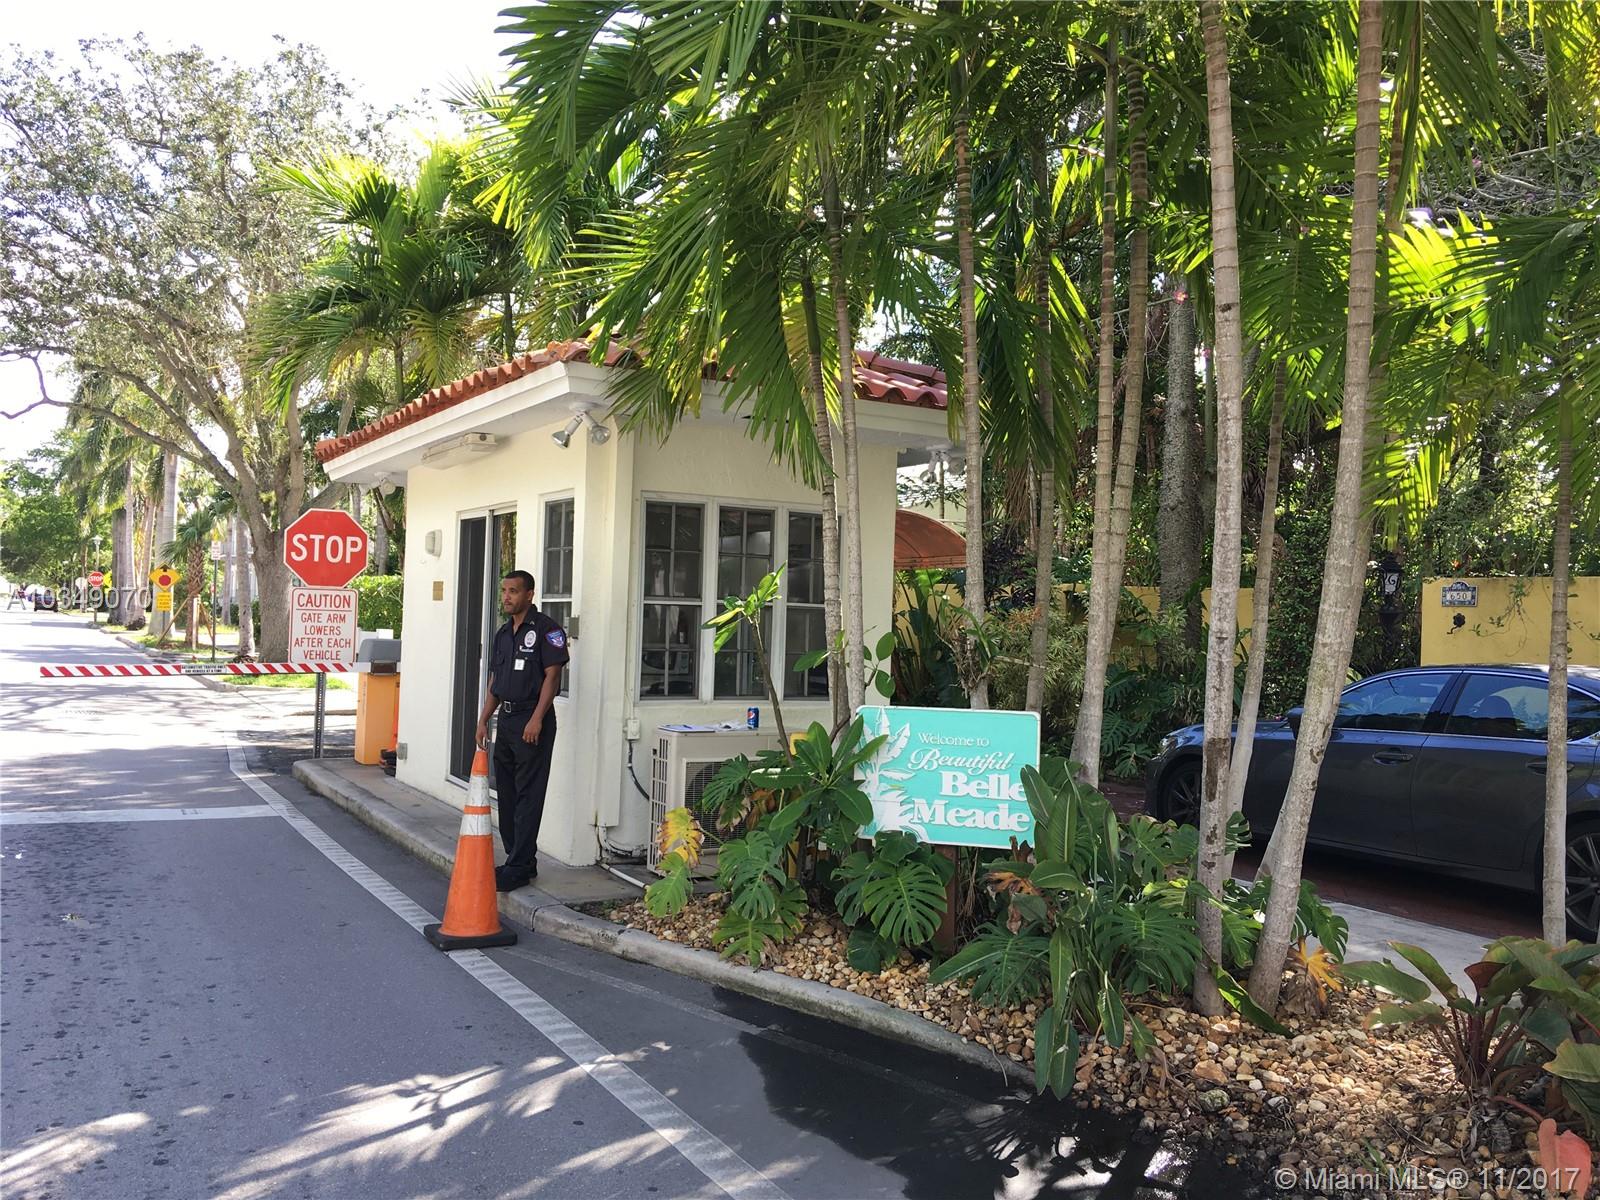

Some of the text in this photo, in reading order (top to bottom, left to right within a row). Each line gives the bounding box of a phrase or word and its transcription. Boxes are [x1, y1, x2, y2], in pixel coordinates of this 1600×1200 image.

[290, 533, 363, 563] STOP
[297, 593, 351, 609] CAUTION
[1450, 592, 1467, 600] 650
[300, 612, 346, 624] GATE ARM
[304, 625, 341, 636] LOWERS
[294, 637, 351, 649] AFTER EACH
[303, 649, 341, 661] VEHICLE
[918, 732, 990, 746] Welcome to
[908, 748, 1015, 775] Beautiful
[940, 771, 1028, 801] Belle
[911, 798, 1030, 832] Meade
